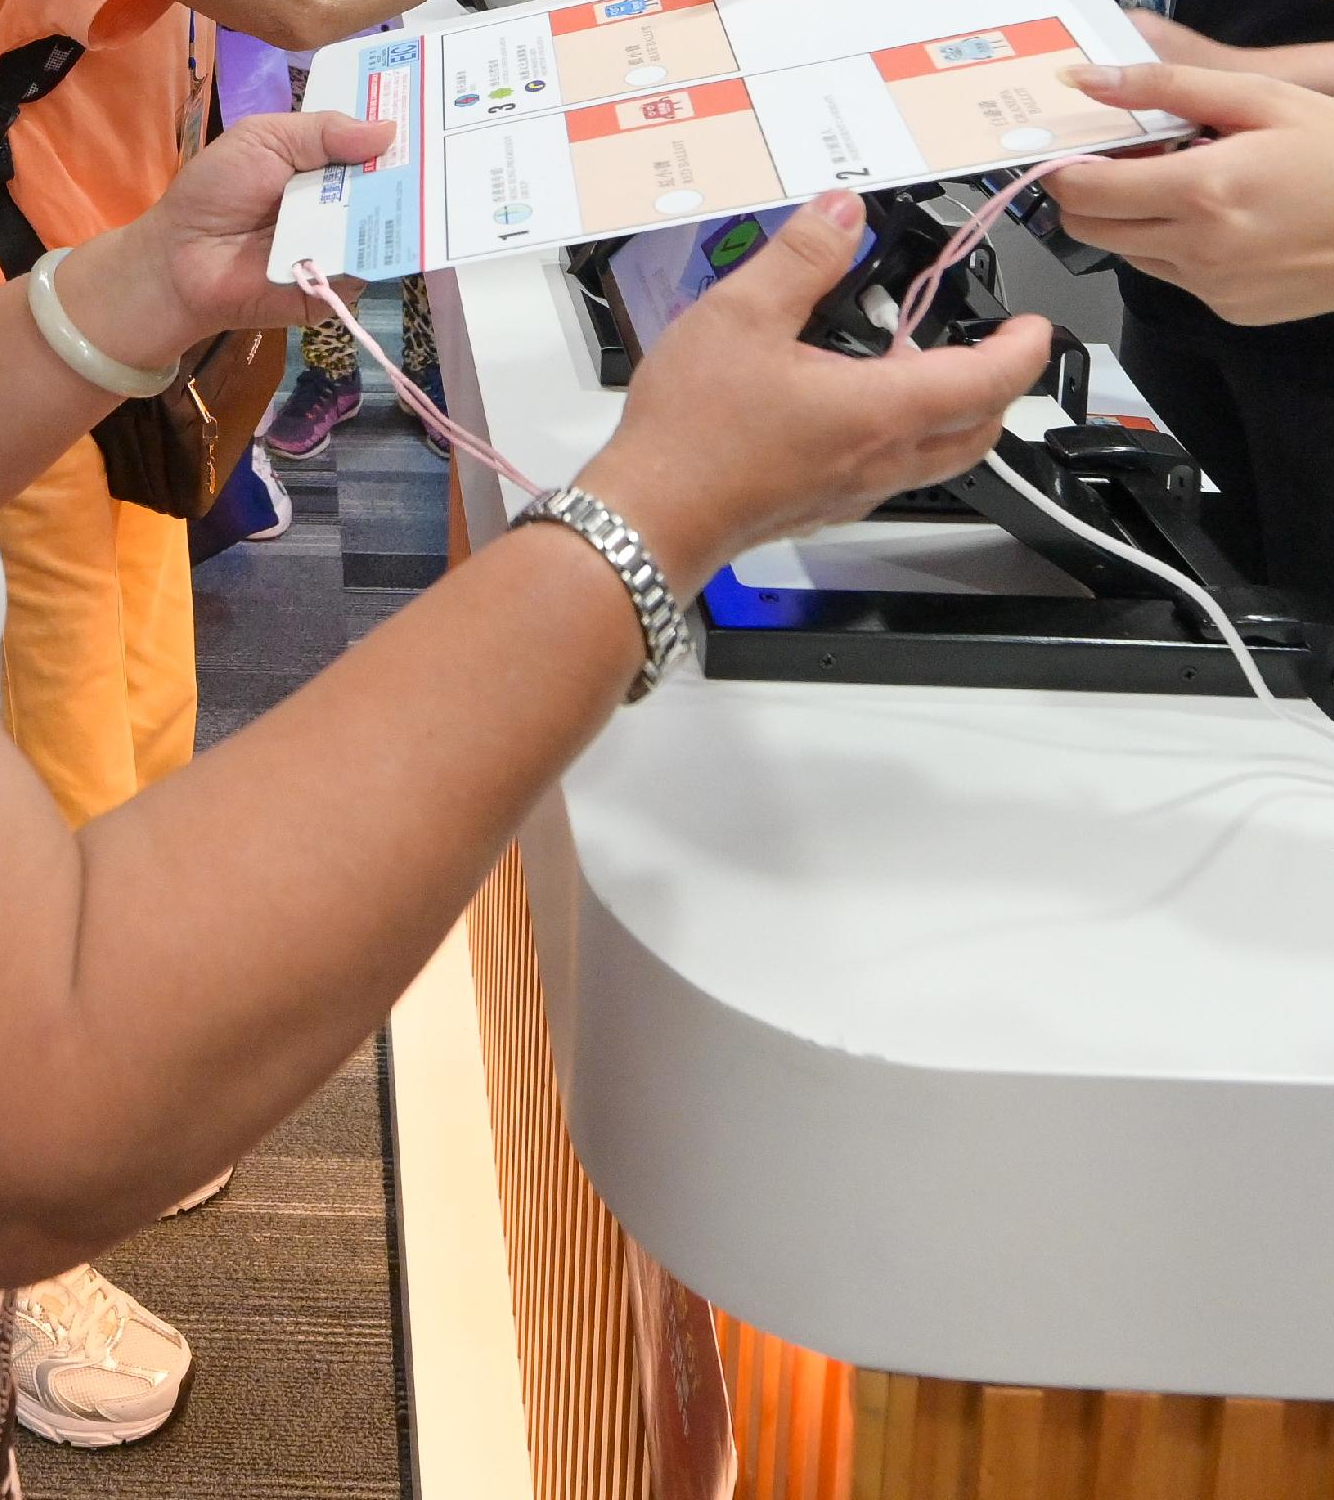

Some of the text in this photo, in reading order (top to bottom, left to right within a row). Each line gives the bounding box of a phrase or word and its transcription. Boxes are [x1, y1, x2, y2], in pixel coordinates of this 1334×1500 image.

[488, 102, 516, 114] 3
[835, 167, 871, 181] 2
[498, 230, 530, 241] 1
